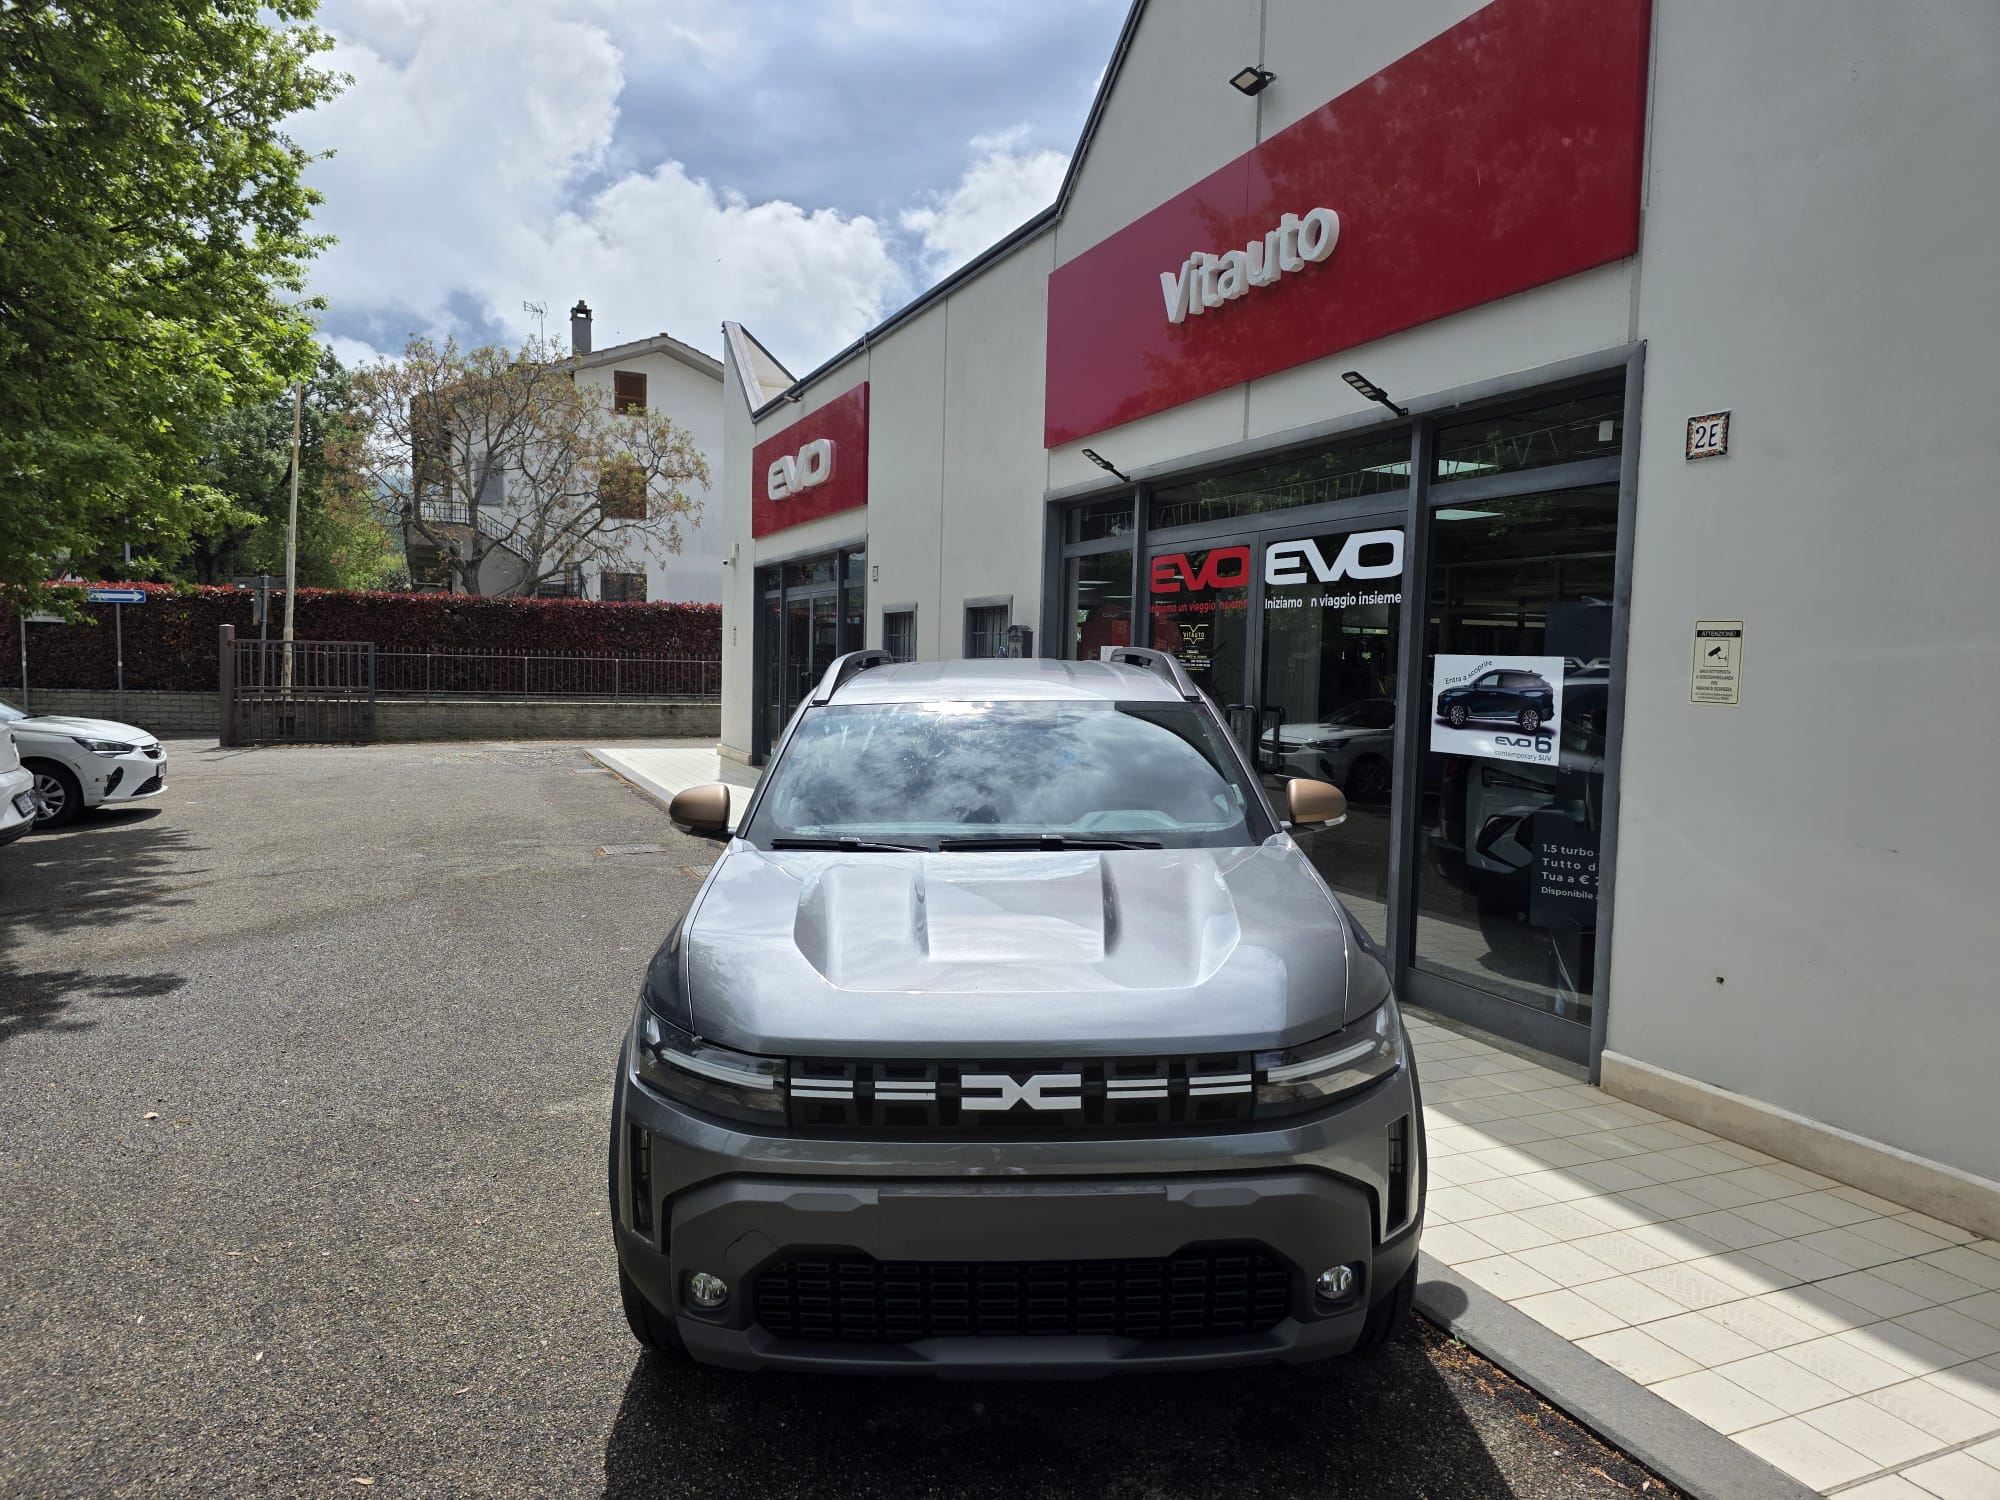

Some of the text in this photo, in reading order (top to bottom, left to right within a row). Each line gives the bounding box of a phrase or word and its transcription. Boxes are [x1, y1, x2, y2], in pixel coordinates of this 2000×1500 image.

[1160, 207, 1340, 323] Vitauto
[1695, 422, 1720, 449] 2E
[767, 438, 832, 501] EVO
[1265, 530, 1405, 586] EVO
[1151, 546, 1250, 593] EVO
[1178, 603, 1188, 612] un
[1189, 599, 1216, 613] viaggio
[1264, 595, 1303, 610] Iniziamo
[1319, 592, 1356, 609] viaggio
[1358, 590, 1402, 605] insieme
[1445, 676, 1462, 685] Entra
[1467, 660, 1493, 679] scoprire
[1494, 734, 1553, 754] EVO 6
[1494, 750, 1537, 761] contemporary
[1542, 844, 1594, 857] 1.5 turbo
[1542, 857, 1581, 870] Tutto
[1541, 871, 1563, 882] Tua
[1541, 886, 1593, 900] Disponibile
